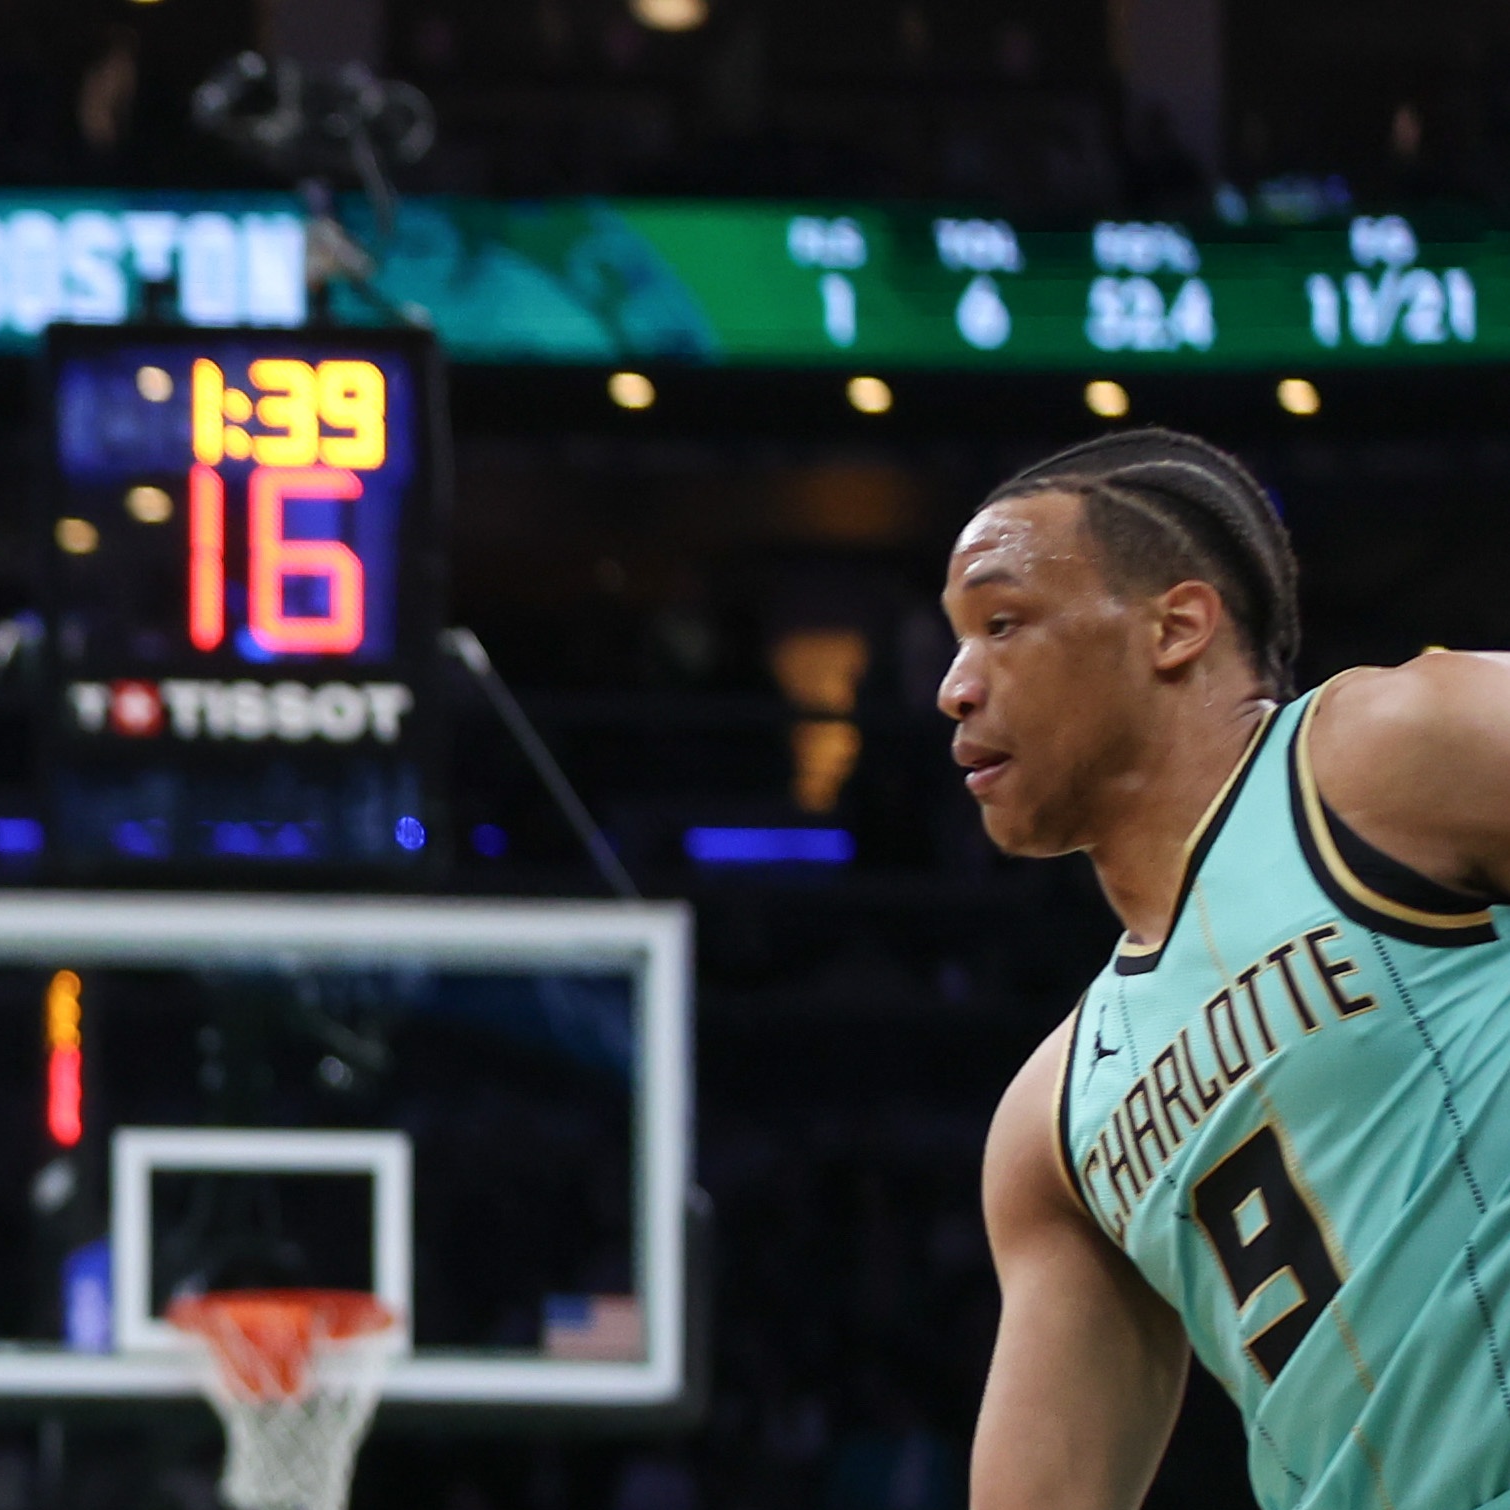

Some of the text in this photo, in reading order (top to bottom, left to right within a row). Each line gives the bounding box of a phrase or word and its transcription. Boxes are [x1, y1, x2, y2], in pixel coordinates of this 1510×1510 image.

[190, 358, 386, 469] 1:39
[188, 463, 365, 654] 16
[161, 678, 415, 743] TISSOT
[1084, 921, 1380, 1247] CHARLOTTE
[1192, 1120, 1356, 1388] 9
